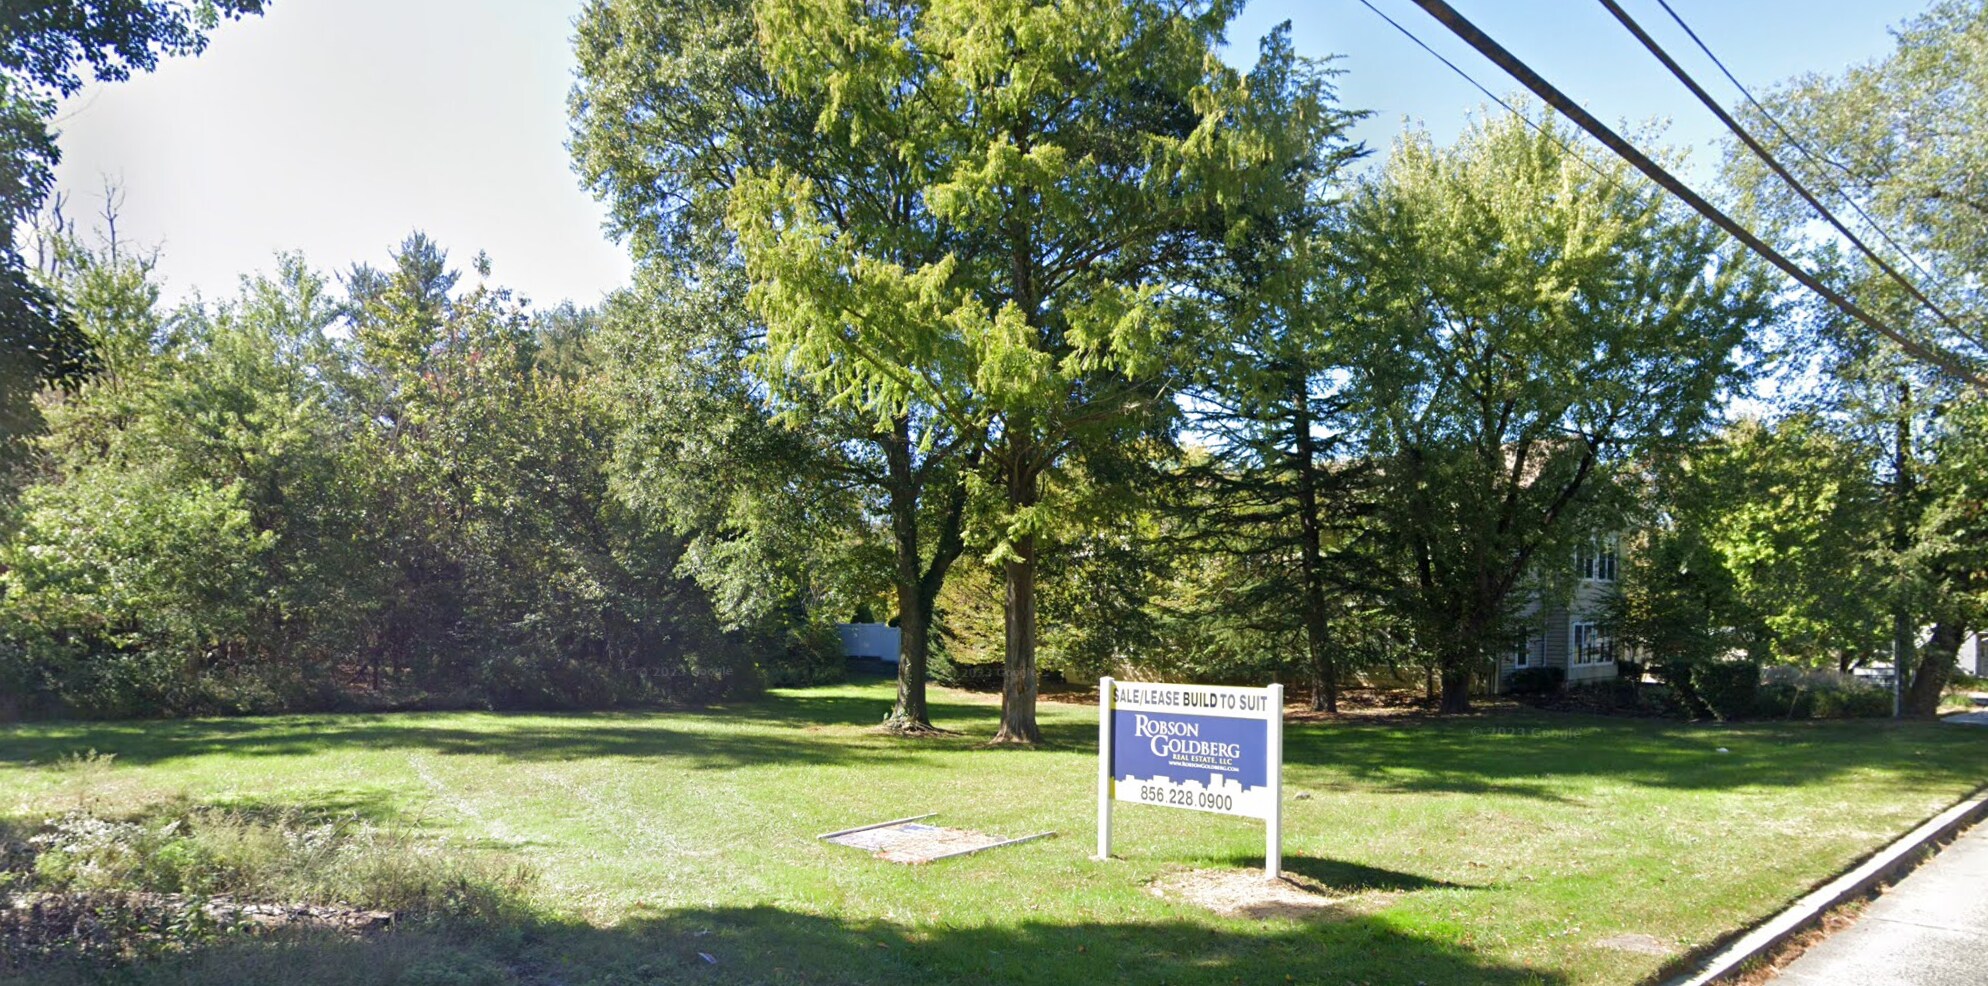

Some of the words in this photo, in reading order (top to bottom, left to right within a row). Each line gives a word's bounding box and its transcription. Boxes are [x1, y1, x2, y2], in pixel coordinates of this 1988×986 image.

[1113, 687, 1180, 706] SALE/LEASE
[1183, 691, 1218, 708] BUILD
[1220, 693, 1236, 709] TO
[1239, 694, 1268, 711] SUIT
[1134, 714, 1199, 737] ROBSON
[1150, 734, 1240, 759] GOLDBERG
[1172, 753, 1189, 761] REAL
[1140, 785, 1232, 811] 856.228.0900
